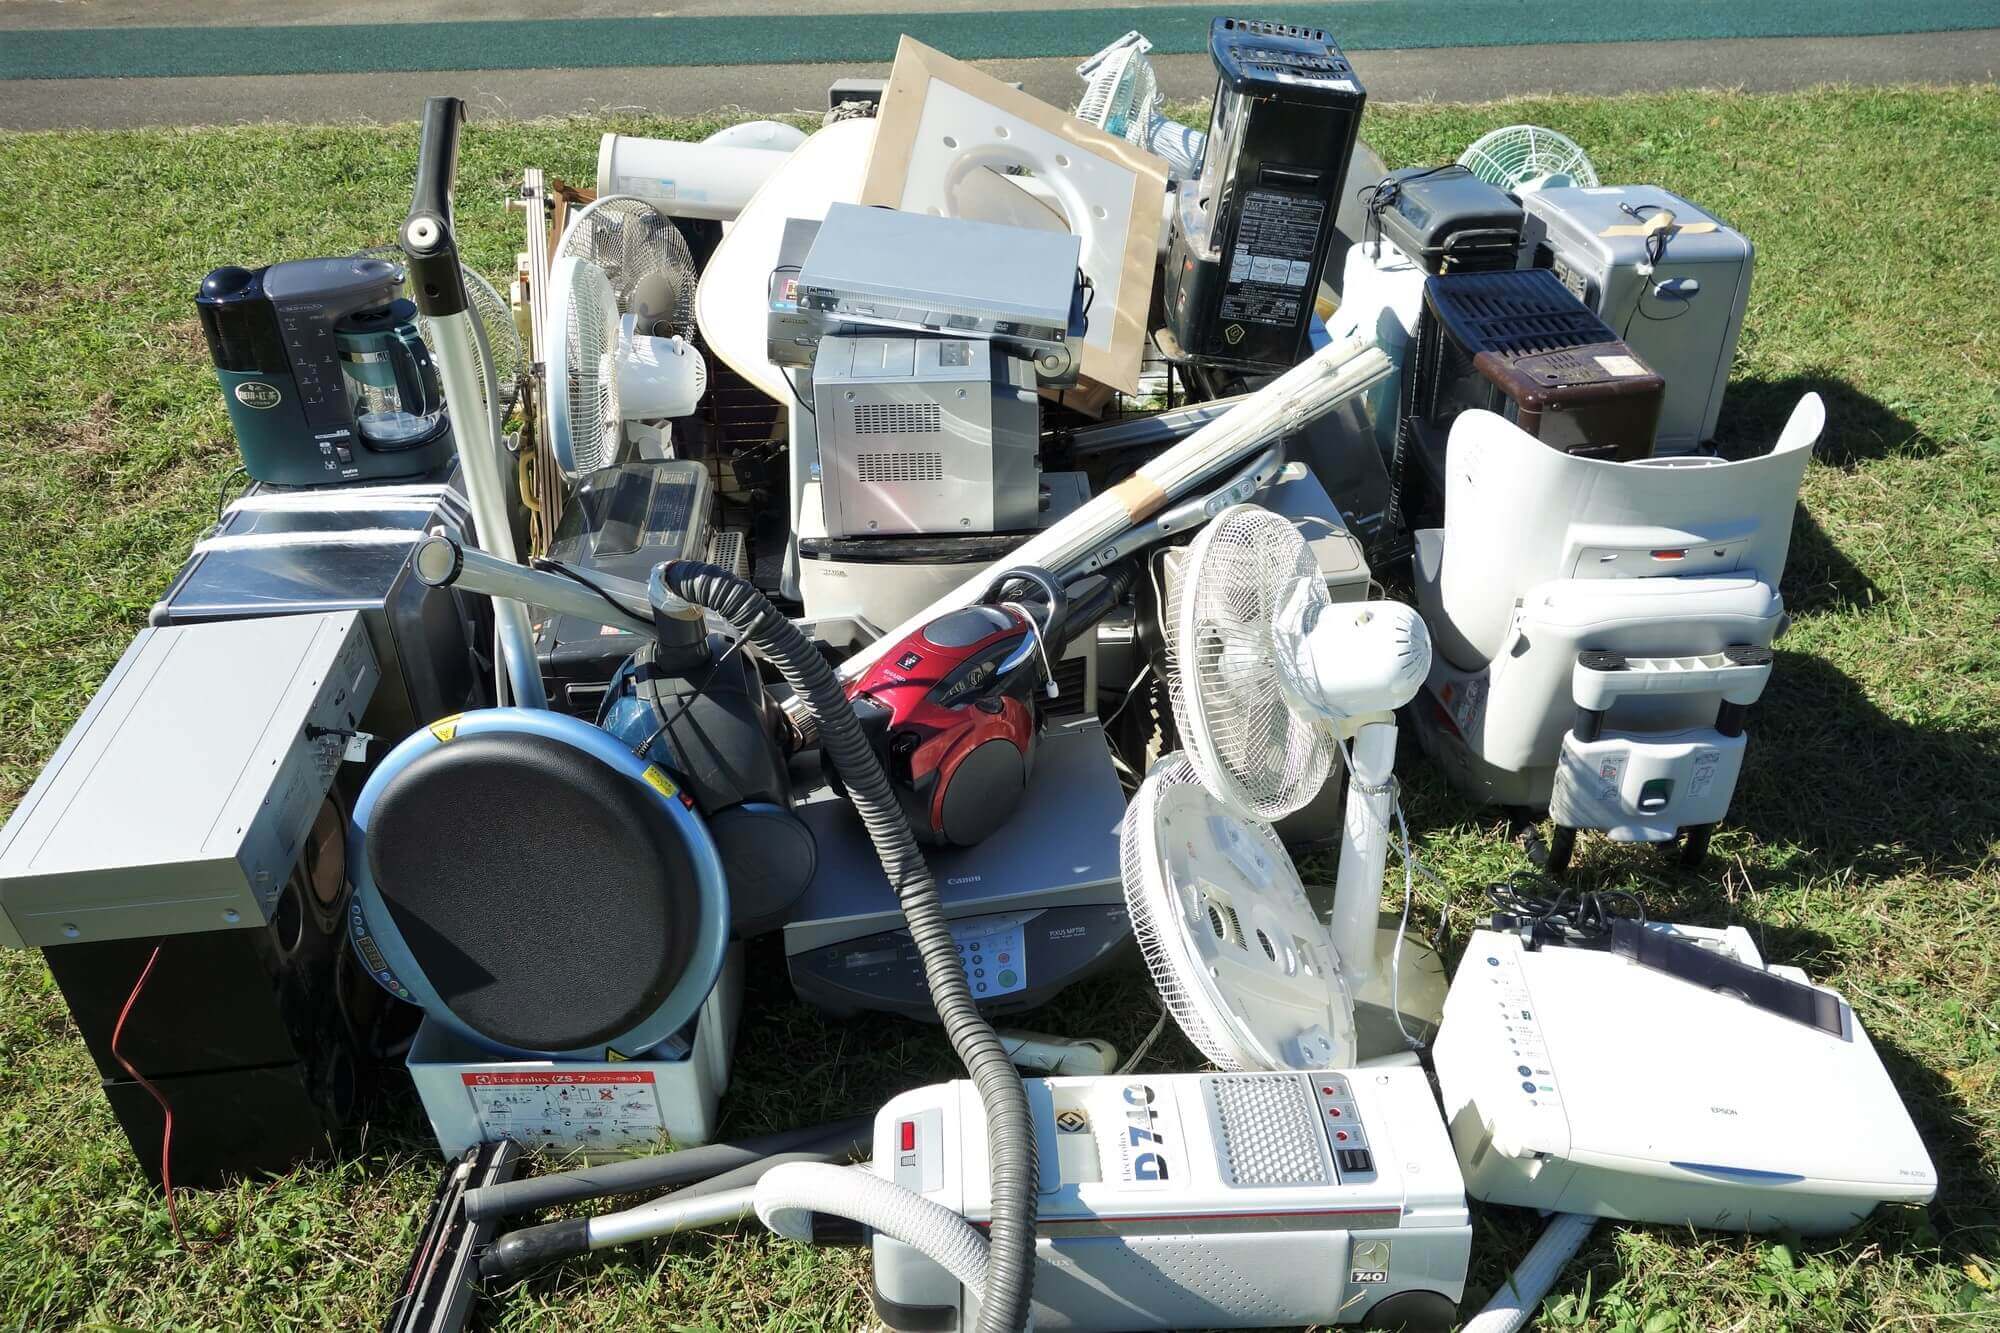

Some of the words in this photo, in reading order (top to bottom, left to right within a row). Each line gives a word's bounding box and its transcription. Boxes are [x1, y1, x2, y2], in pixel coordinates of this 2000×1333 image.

[883, 668, 906, 682] SHARP
[947, 874, 982, 886] Canon
[493, 1075, 549, 1083] Electrolux
[1710, 1106, 1738, 1116] EPSON
[1123, 1083, 1169, 1180] D740
[1355, 1272, 1383, 1281] 740
